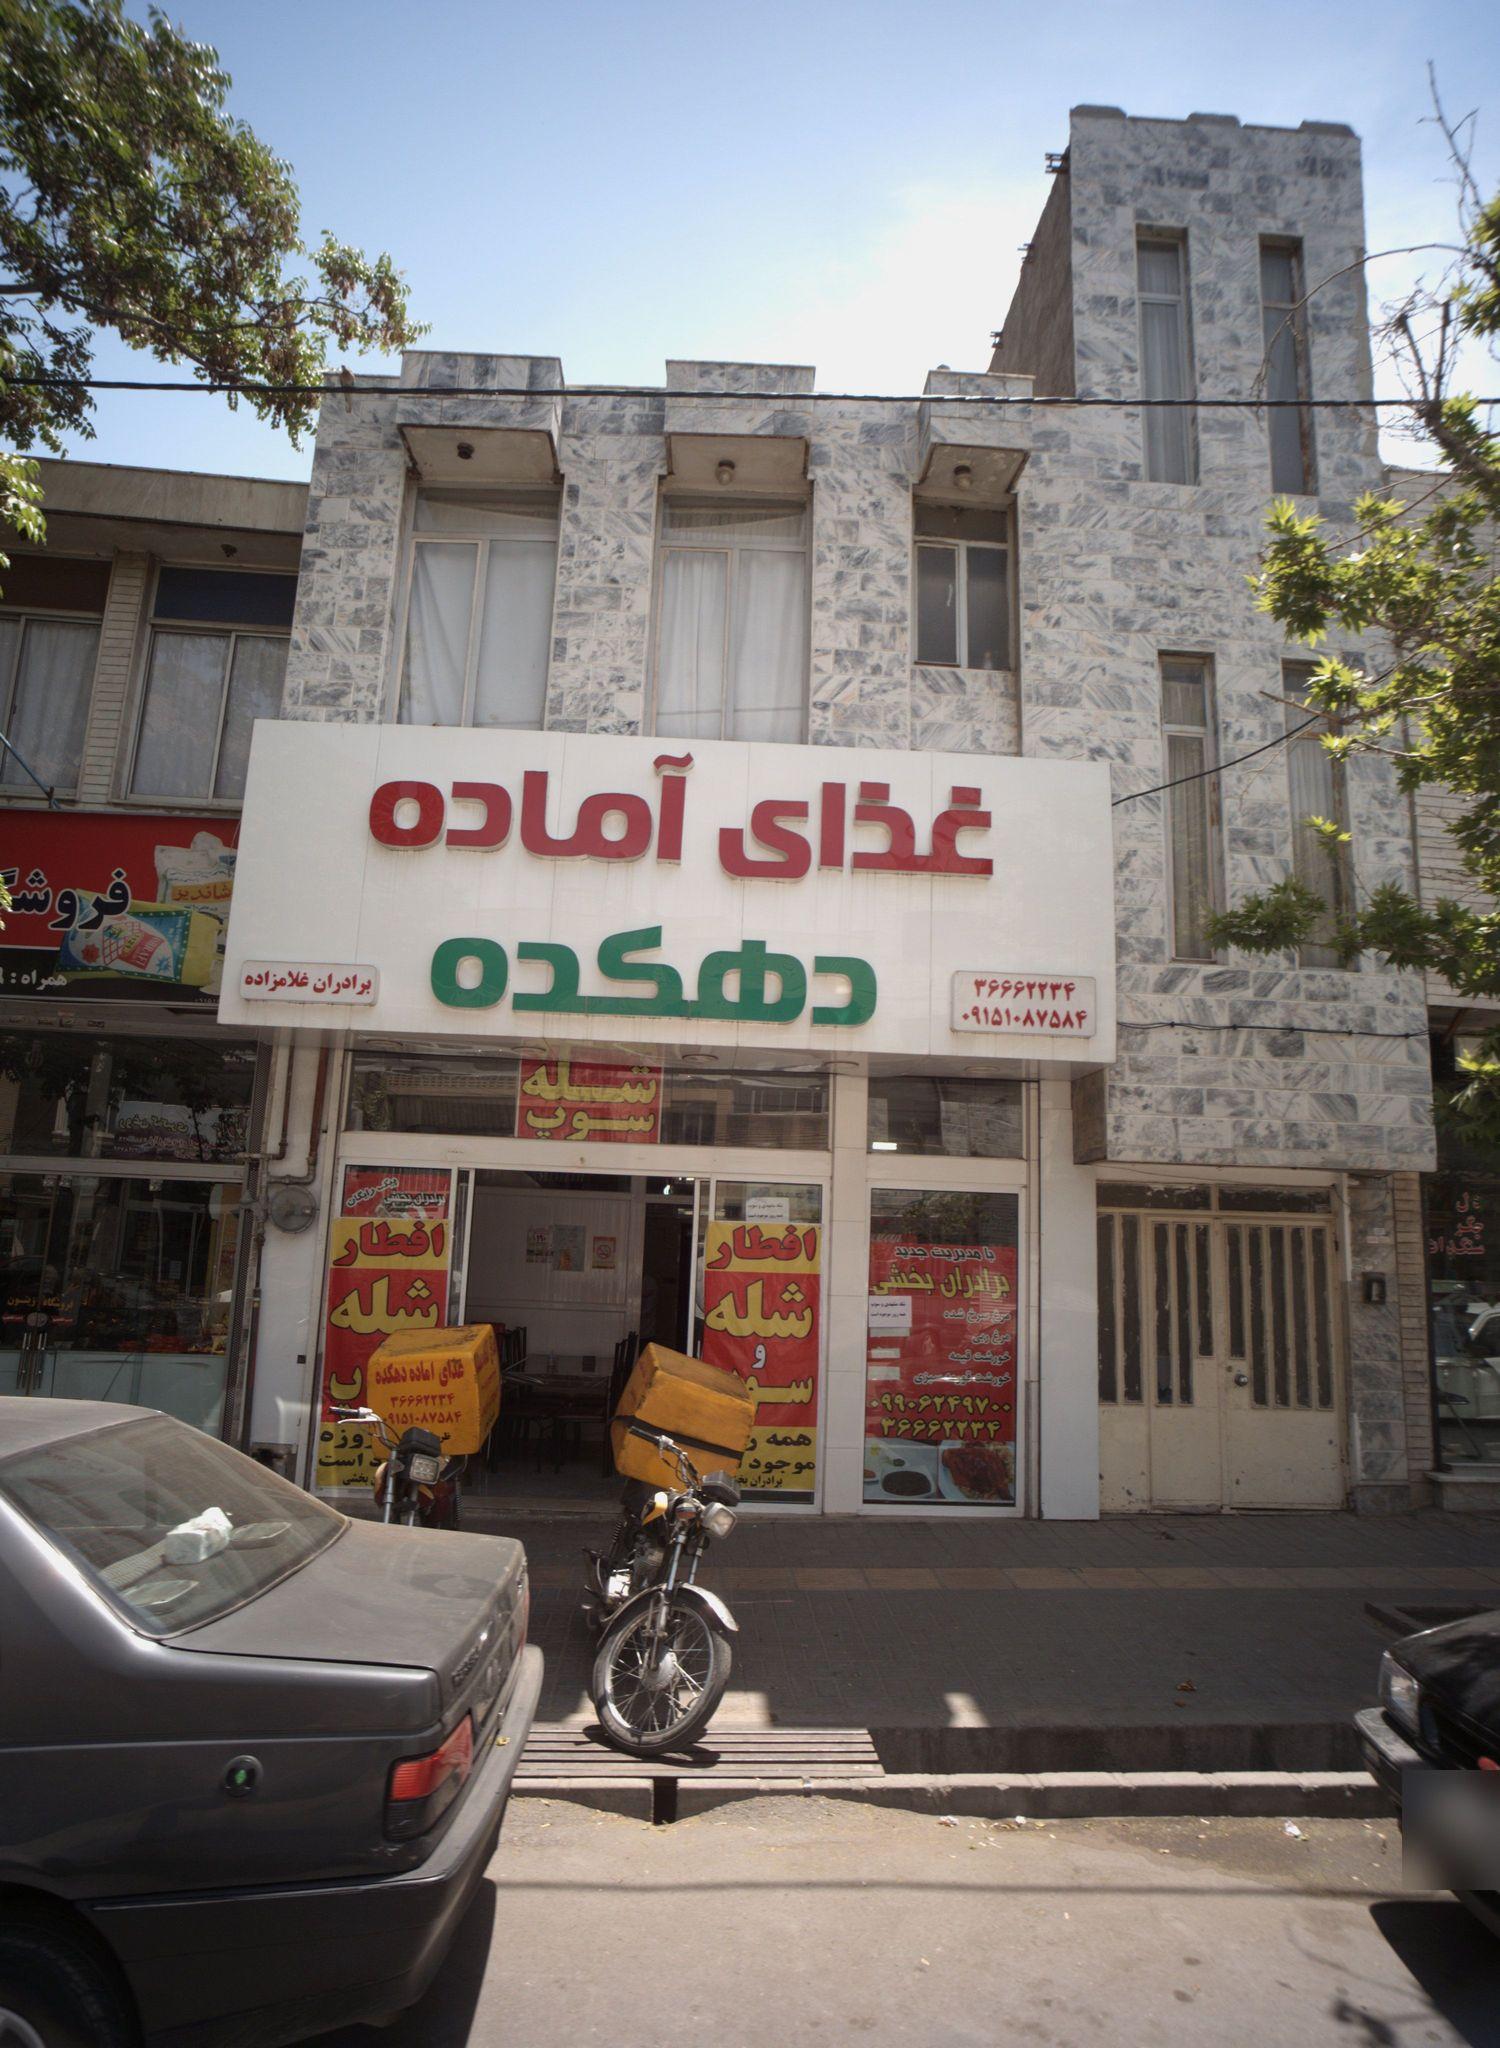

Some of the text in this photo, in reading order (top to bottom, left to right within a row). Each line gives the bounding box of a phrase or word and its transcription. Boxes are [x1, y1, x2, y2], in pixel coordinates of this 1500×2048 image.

[369, 752, 995, 883] غذای آماده
[244, 970, 371, 995] برادران غلامزاده
[430, 925, 878, 1028] دهکده
[974, 978, 1076, 1001] ۳۶۶۶۲۲۳۴
[962, 1005, 1087, 1029] ۰۹۱۵۱۰۸۷۵۸۴
[526, 1105, 655, 1140] سوپ
[332, 1224, 445, 1266] افطار
[706, 1224, 817, 1270] افطار
[896, 1245, 996, 1261] با مدیریت جدید
[872, 1263, 1010, 1299] برادران بخشی
[329, 1274, 439, 1335] شله
[704, 1278, 814, 1339] شله
[991, 1329, 1011, 1345] مرغ
[751, 1343, 766, 1369] و
[973, 1350, 1012, 1366] خورشت
[389, 1392, 456, 1409] ۳۶۶۶۲۲۳۴
[735, 1375, 814, 1413] سو
[870, 1392, 1012, 1414] ۰۹۹۰۶۲۴۹۷۰۰
[766, 1433, 812, 1446] همه
[880, 1416, 1001, 1439] ۳۶۶۶۲۲۳۴
[319, 1453, 363, 1467] است
[748, 1457, 816, 1475] موجود
[749, 1475, 783, 1488] برادران
